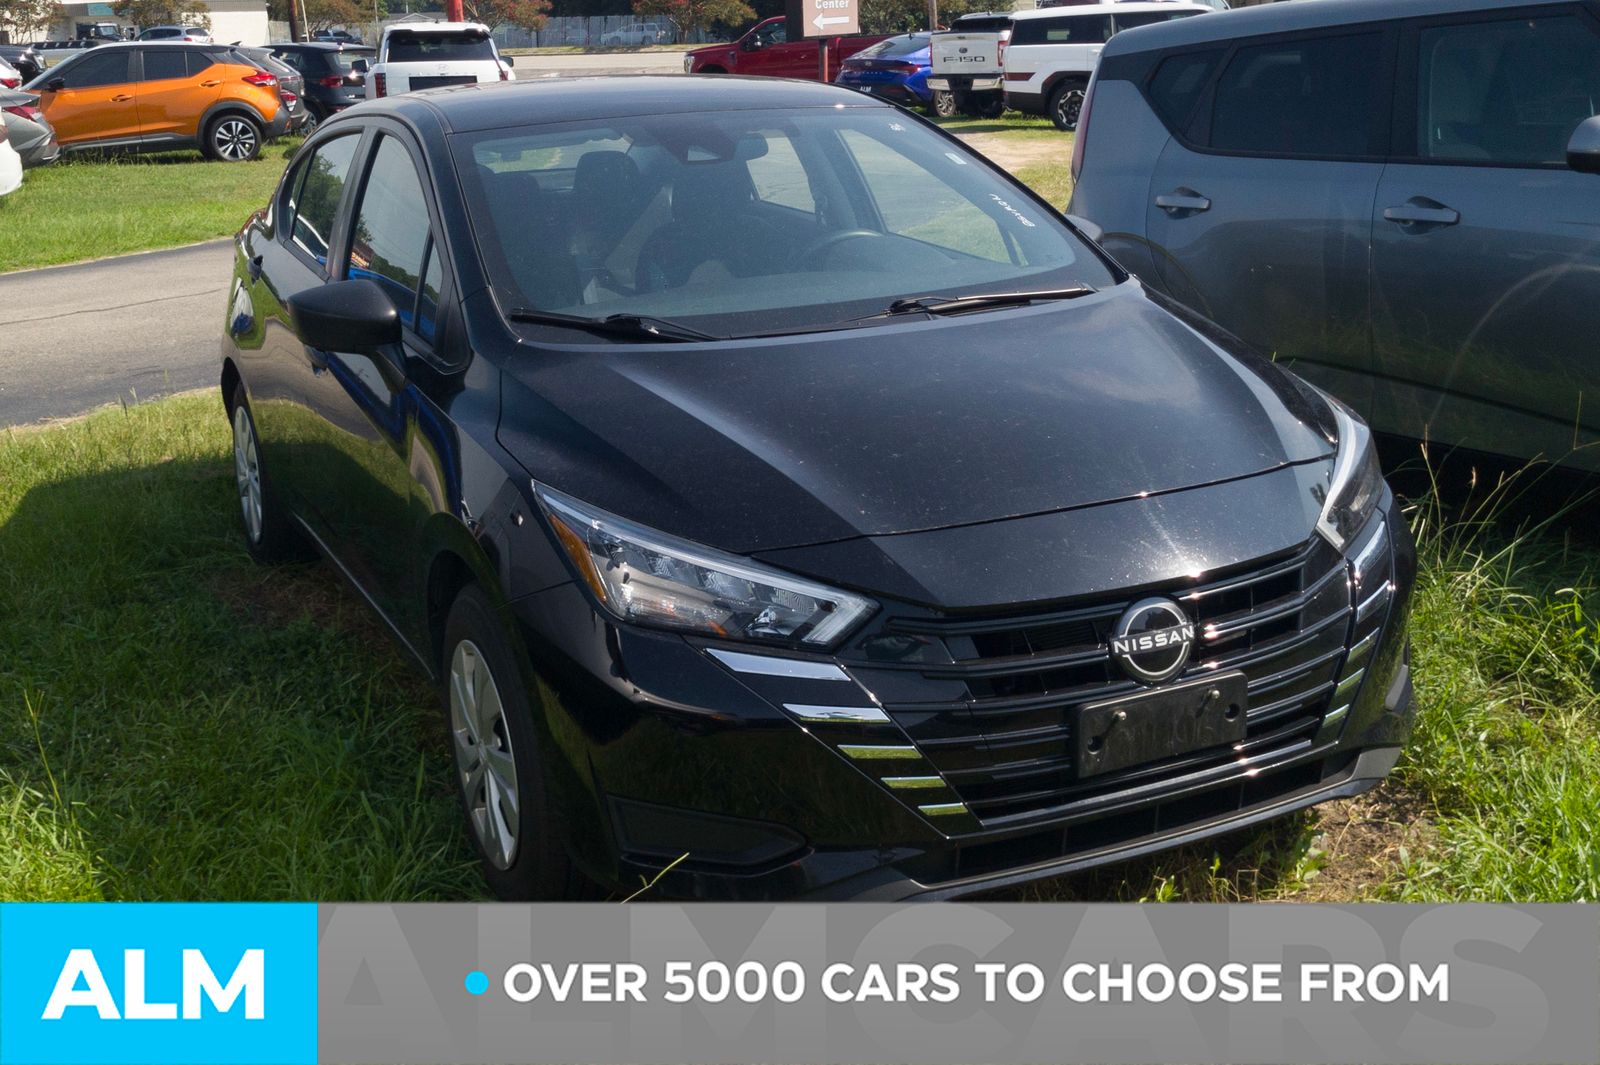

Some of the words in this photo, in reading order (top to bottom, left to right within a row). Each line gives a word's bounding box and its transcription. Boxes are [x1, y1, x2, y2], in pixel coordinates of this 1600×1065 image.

[815, 0, 849, 9] Center
[943, 55, 985, 63] F-150
[1113, 625, 1195, 654] NISSAN
